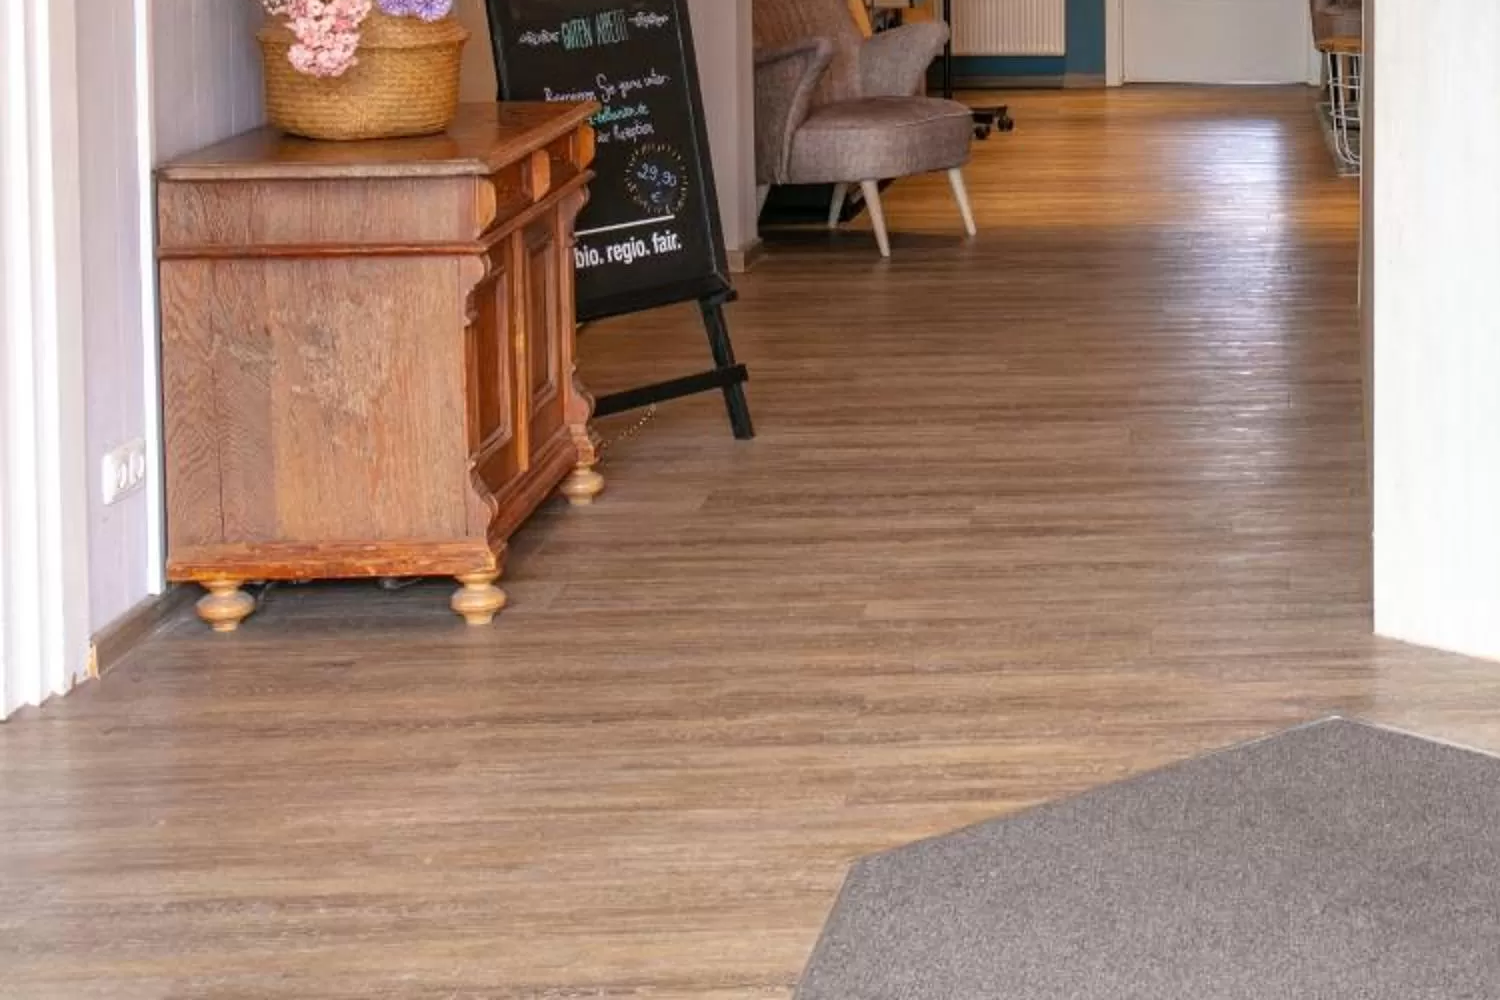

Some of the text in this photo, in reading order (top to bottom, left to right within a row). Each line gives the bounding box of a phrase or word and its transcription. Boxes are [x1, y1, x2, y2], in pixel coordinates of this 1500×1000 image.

[574, 229, 683, 269] bio. regio. fair.
